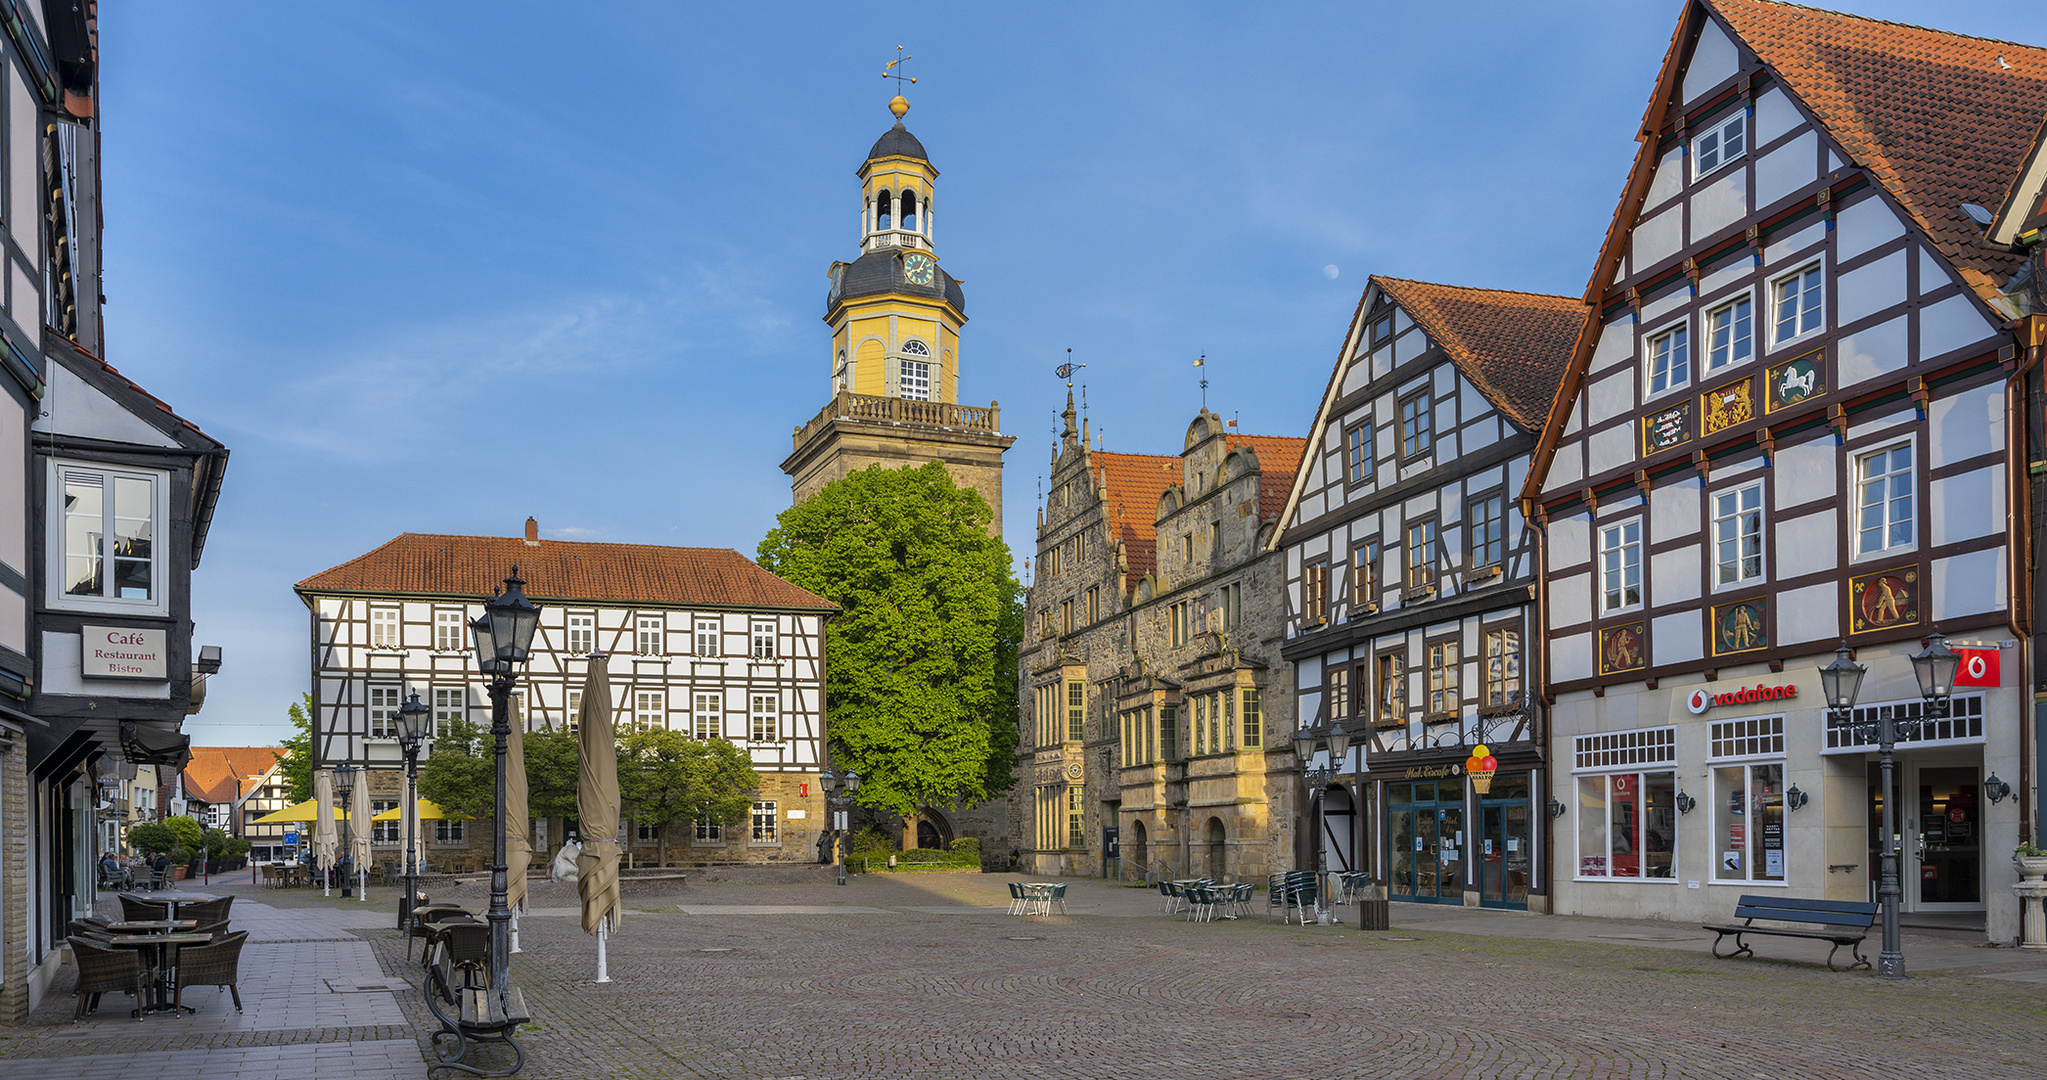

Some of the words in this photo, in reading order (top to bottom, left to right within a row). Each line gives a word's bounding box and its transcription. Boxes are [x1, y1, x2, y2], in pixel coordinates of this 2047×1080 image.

[107, 632, 144, 646] Café
[95, 649, 156, 660] Restaurant
[109, 664, 142, 674] Bistro
[1713, 683, 1797, 707] vodafone
[2012, 793, 2019, 803] 4
